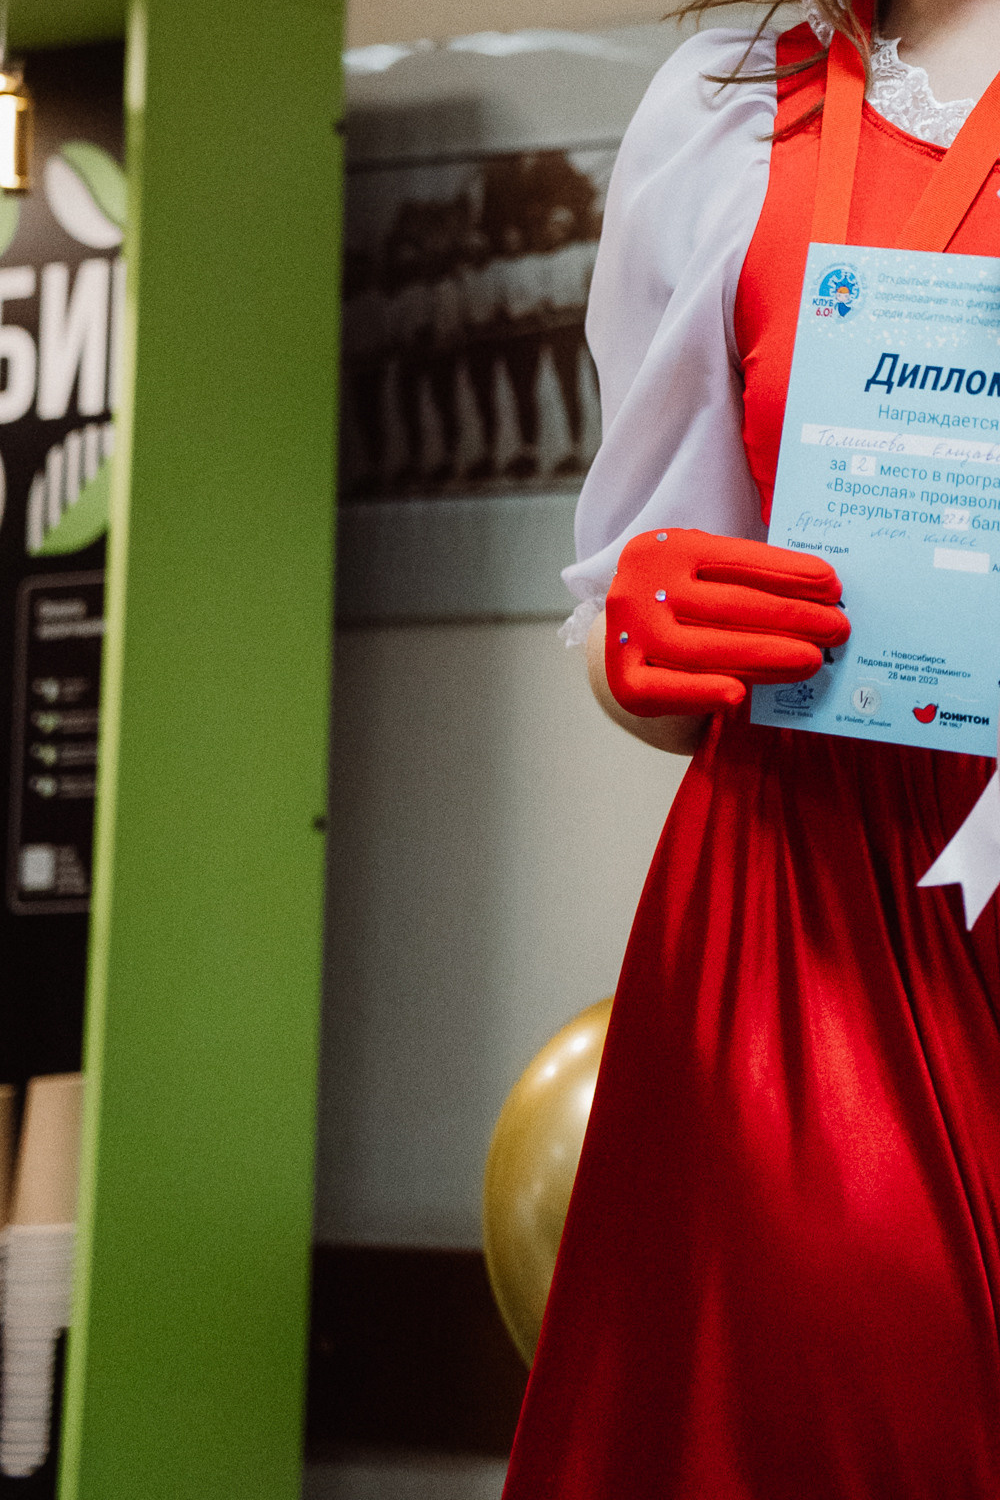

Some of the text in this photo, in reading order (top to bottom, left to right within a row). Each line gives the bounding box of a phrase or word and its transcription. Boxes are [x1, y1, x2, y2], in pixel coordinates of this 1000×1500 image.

[812, 297, 834, 308] КЛУБ
[0, 258, 126, 422] БИ
[878, 404, 1000, 431] Награждается
[829, 459, 847, 471] за
[880, 465, 927, 481] место
[932, 471, 941, 481] в
[826, 477, 916, 500] «Взрослая»
[827, 501, 836, 512] с
[840, 502, 941, 525] результатом
[787, 538, 849, 554] Главный судья
[857, 656, 971, 679] Ледовая арена «Фламинго»
[882, 649, 946, 665] г. Новосибирск
[888, 671, 939, 686] 28 мая 2023
[940, 710, 990, 726] ЮНИТОН
